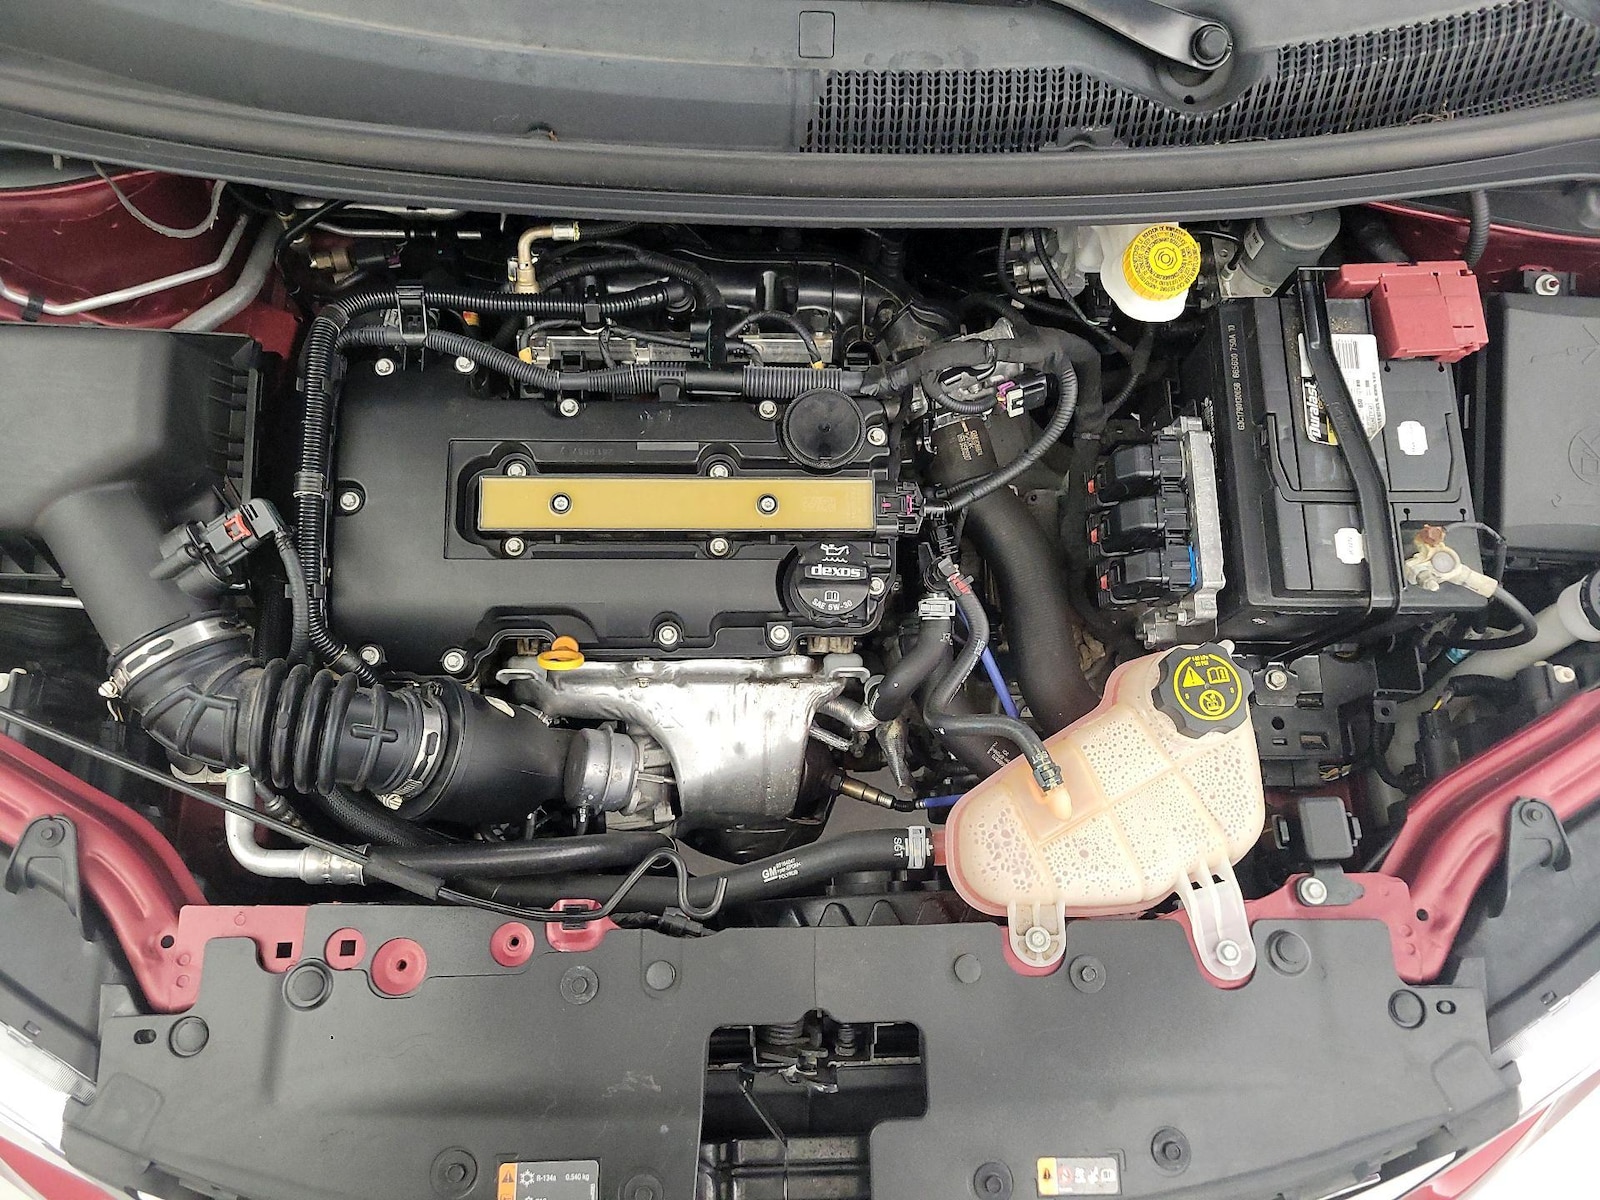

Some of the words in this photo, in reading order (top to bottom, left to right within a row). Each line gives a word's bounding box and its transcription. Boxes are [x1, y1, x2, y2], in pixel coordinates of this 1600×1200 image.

[1305, 382, 1322, 439] Duralast
[811, 564, 861, 578] dexos
[811, 598, 826, 610] SAE
[828, 600, 853, 611] 5W-30
[894, 837, 904, 859] SGT
[762, 866, 778, 879] GM
[536, 1174, 557, 1182] R-134a
